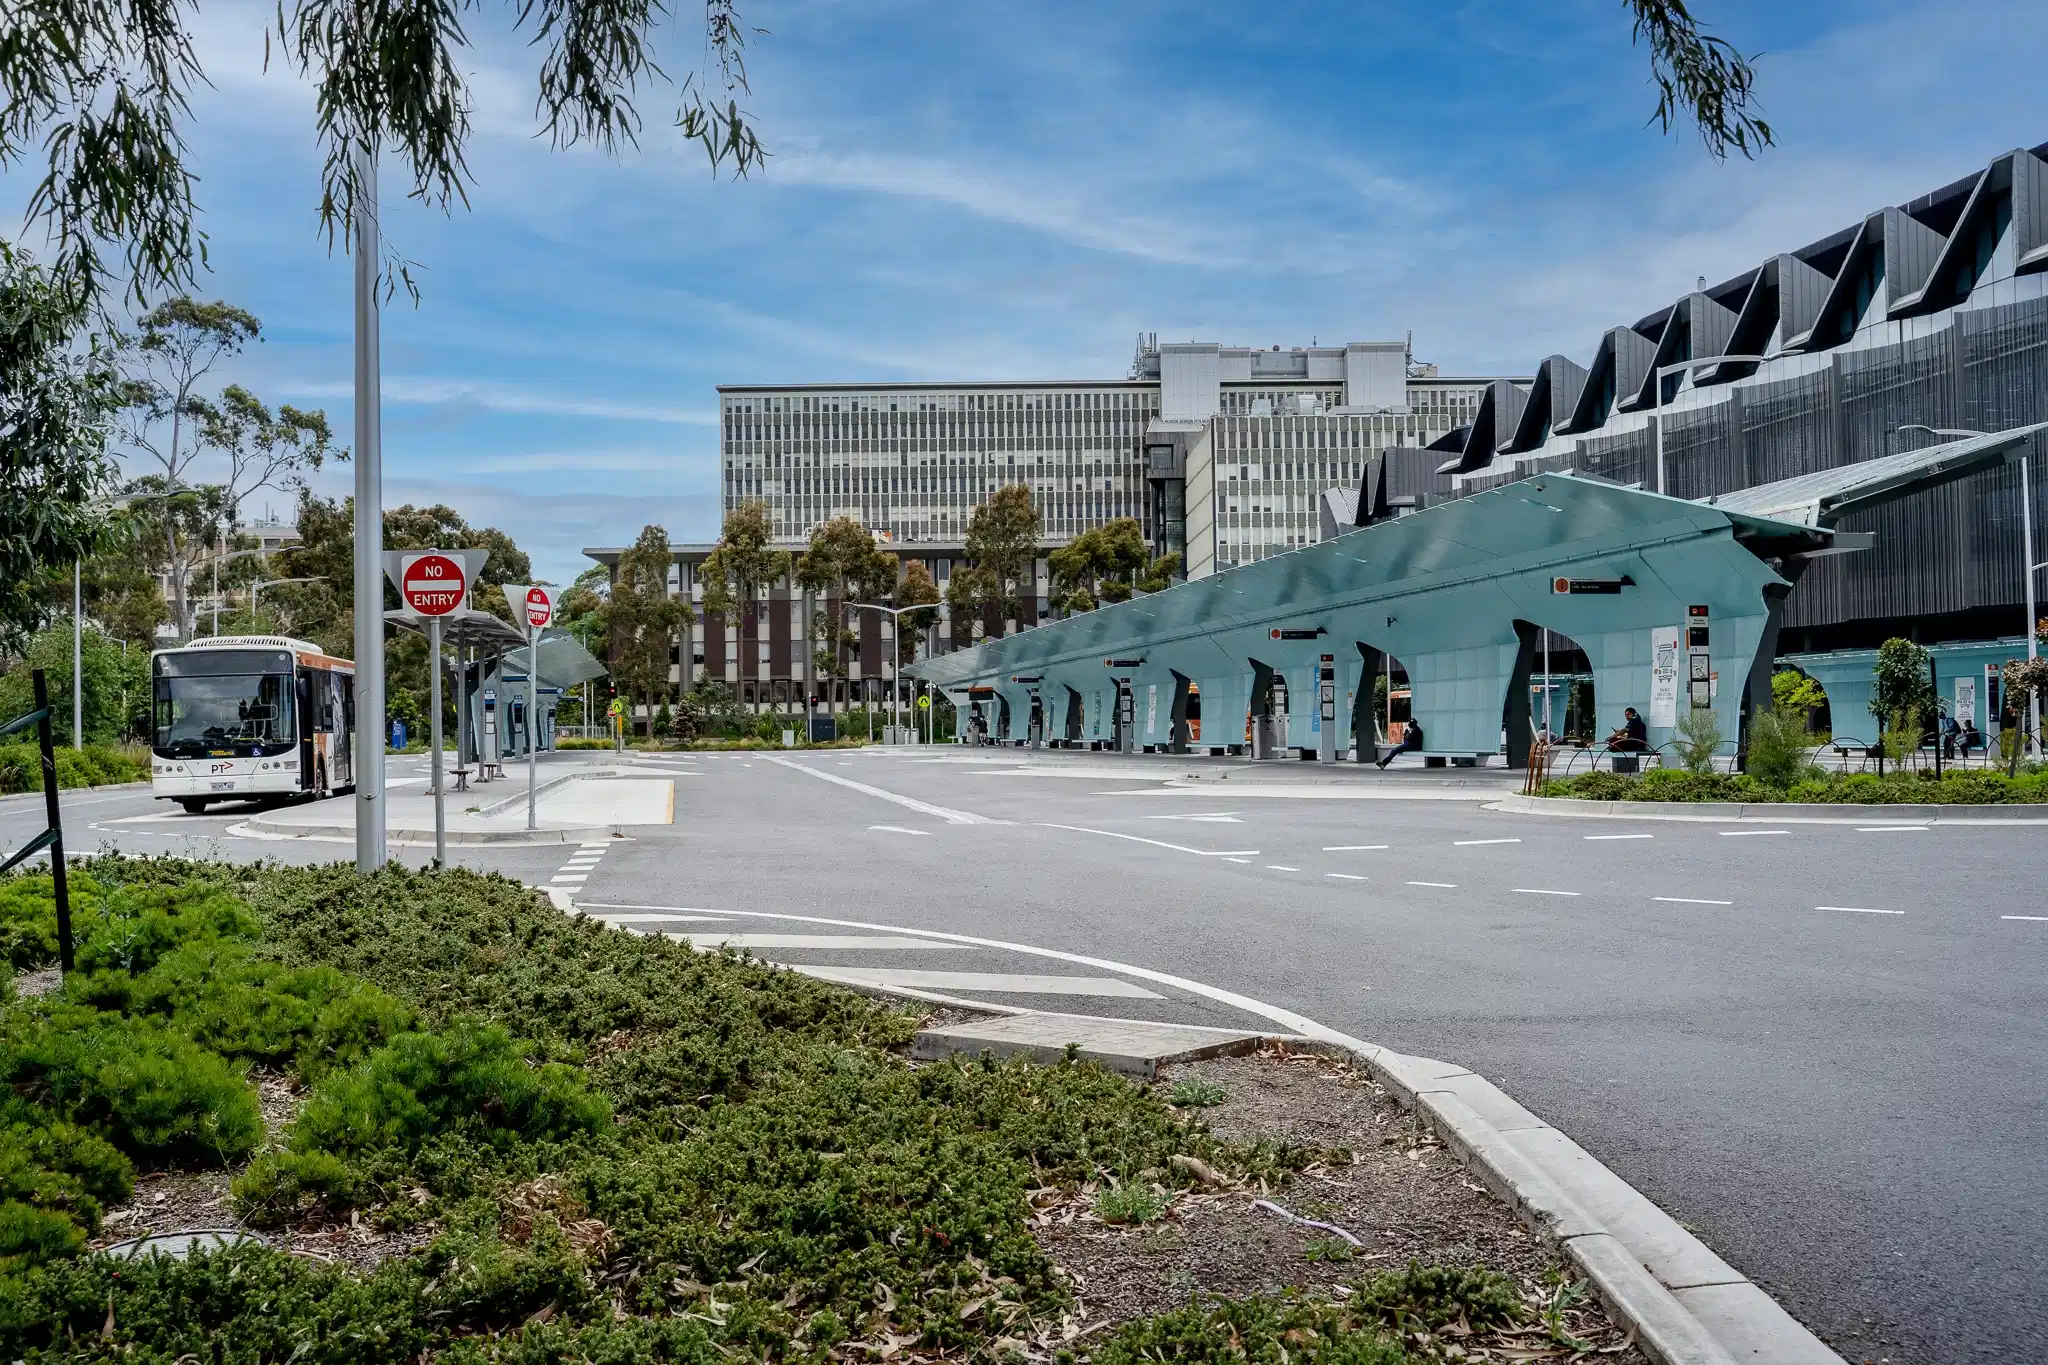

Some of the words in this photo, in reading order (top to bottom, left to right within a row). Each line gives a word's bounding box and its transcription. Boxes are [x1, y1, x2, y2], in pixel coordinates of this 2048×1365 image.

[425, 565, 443, 577] NO
[414, 593, 456, 606] ENTRY
[532, 593, 541, 603] NO
[528, 611, 547, 621] ENTRY
